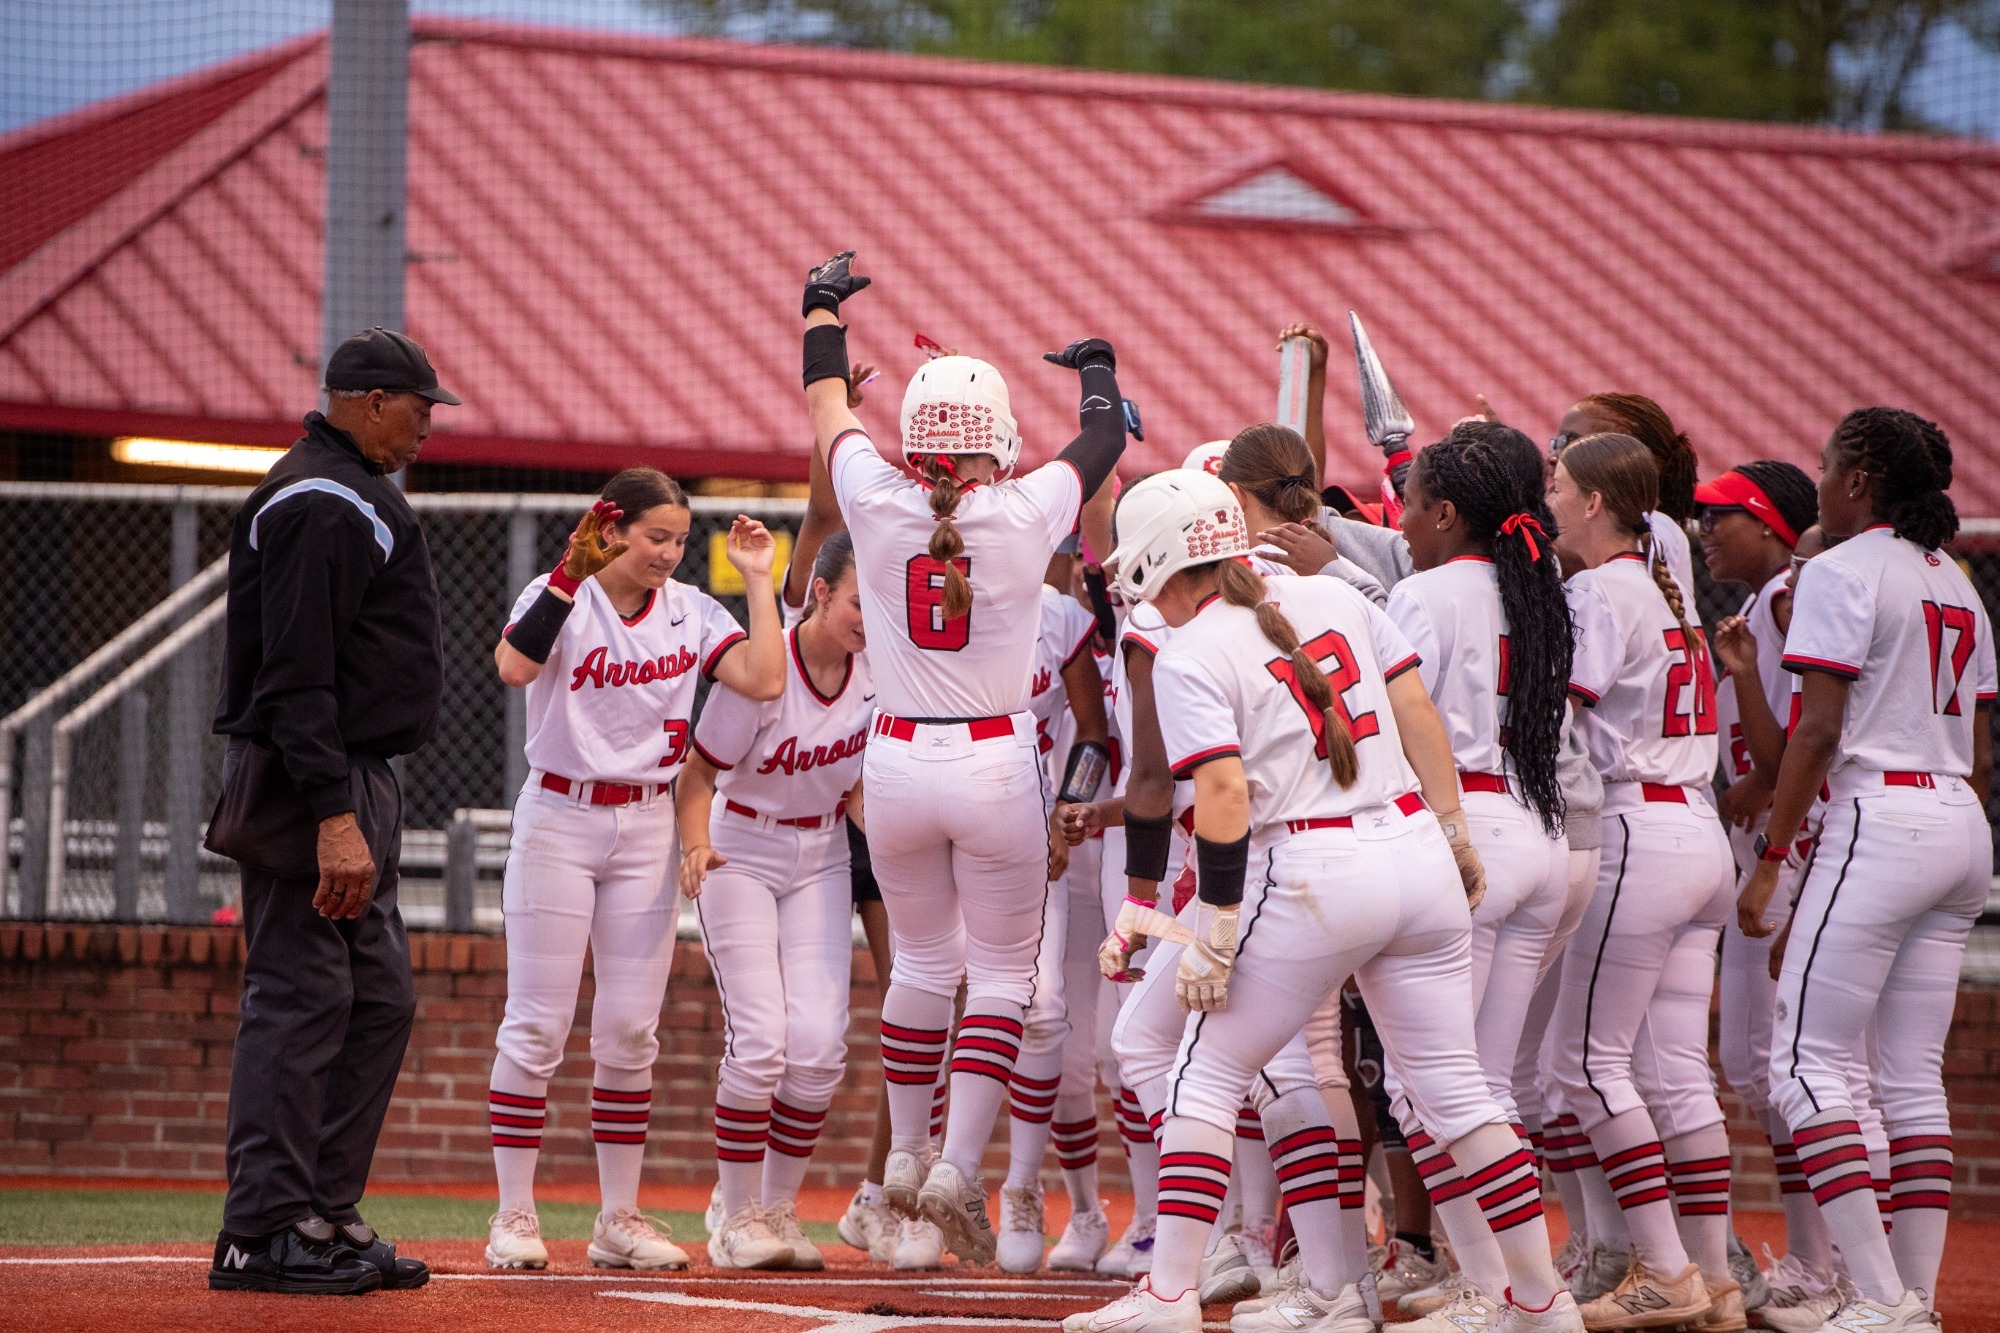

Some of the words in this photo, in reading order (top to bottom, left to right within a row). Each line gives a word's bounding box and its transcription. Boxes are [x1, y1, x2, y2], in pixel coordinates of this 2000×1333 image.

[906, 553, 971, 652] 6
[570, 644, 698, 691] Arrows
[1921, 600, 1976, 716] 17
[1264, 628, 1380, 761] 12
[658, 718, 689, 767] 3
[756, 726, 868, 775] Arrow
[222, 1245, 250, 1270] N
